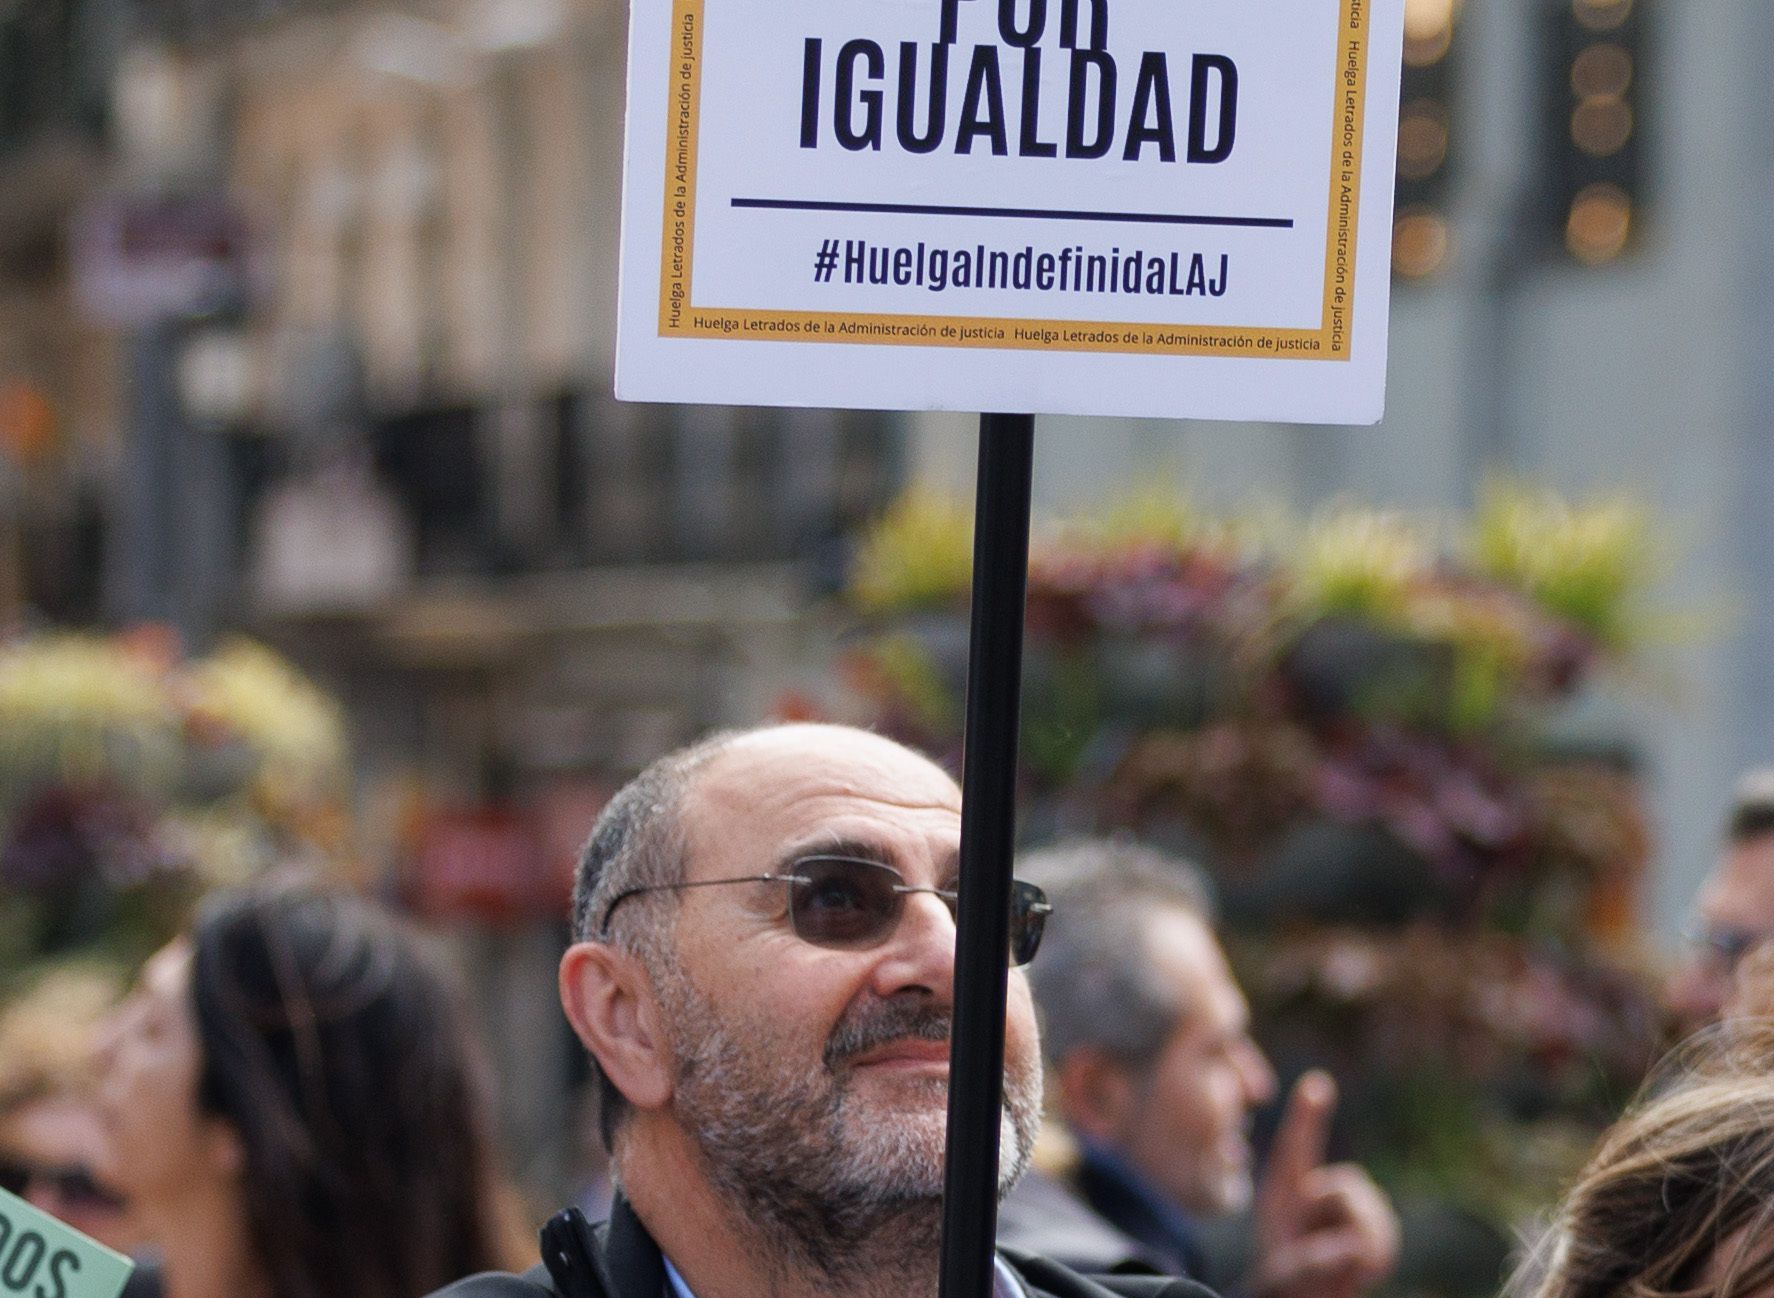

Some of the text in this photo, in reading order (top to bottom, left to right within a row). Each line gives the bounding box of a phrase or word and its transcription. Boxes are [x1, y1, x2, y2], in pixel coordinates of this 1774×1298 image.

[1344, 40, 1360, 87] Huelga
[800, 38, 1238, 164] IGUALDAD
[1342, 90, 1358, 147] Letrados
[668, 13, 695, 328] Huelga Letrados de la Administración de justicia
[1341, 150, 1354, 168] de
[1341, 170, 1352, 183] la
[1335, 185, 1353, 284] Administración
[814, 239, 1229, 297] #HuelgaIndefinidaLAJ
[1334, 286, 1346, 304] de
[693, 316, 1321, 352] Huelga Letrados de la Administración de justicia Huelga Letrados de la Administración de justicia
[1330, 306, 1346, 352] justicia
